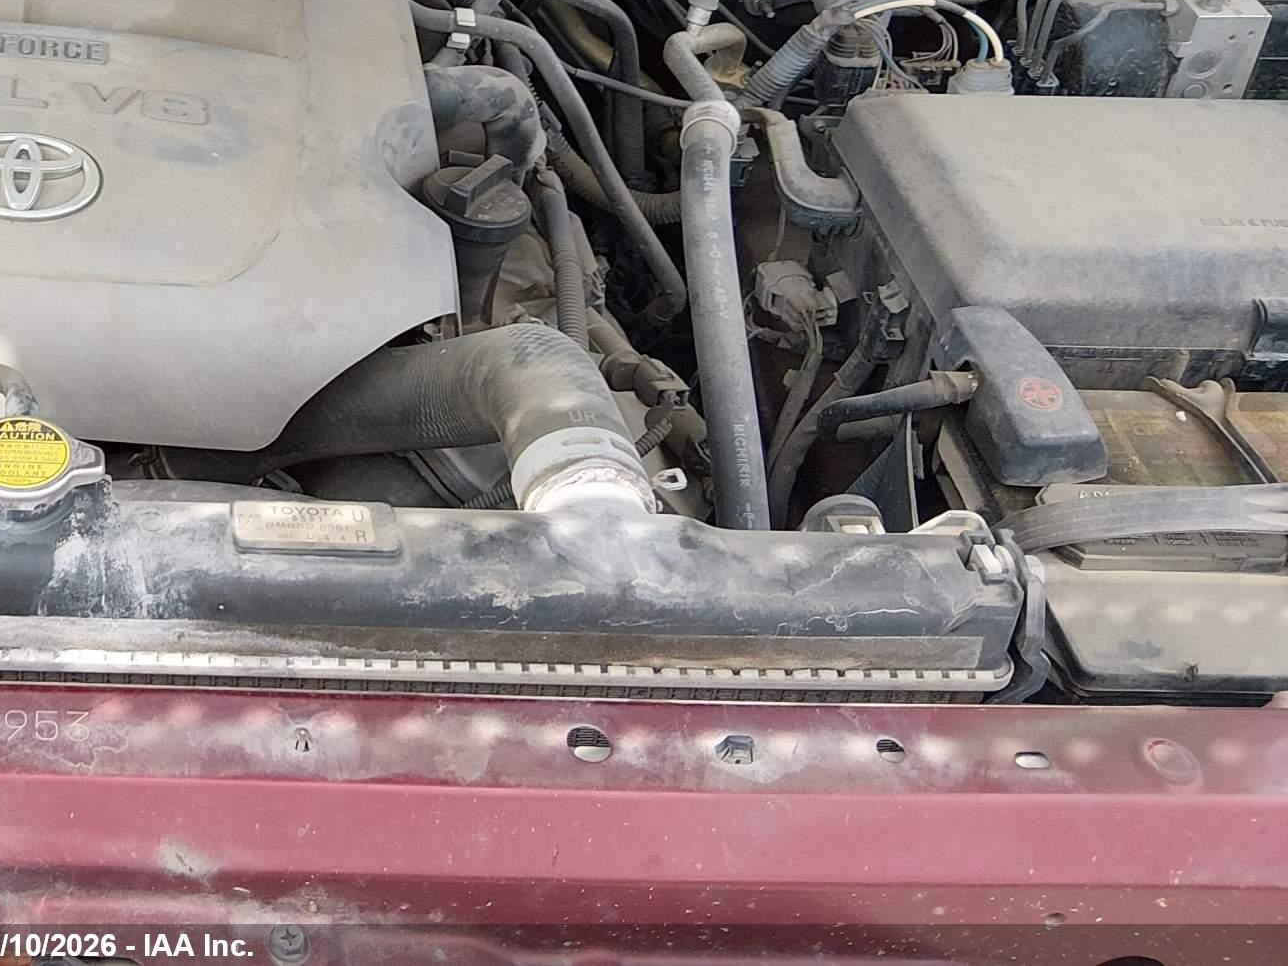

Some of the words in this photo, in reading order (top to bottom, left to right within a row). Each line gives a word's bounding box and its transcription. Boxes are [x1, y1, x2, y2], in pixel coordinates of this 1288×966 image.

[70, 81, 209, 125] V8
[271, 505, 344, 517] TOYOTA
[351, 509, 364, 523] U
[355, 529, 368, 543] R
